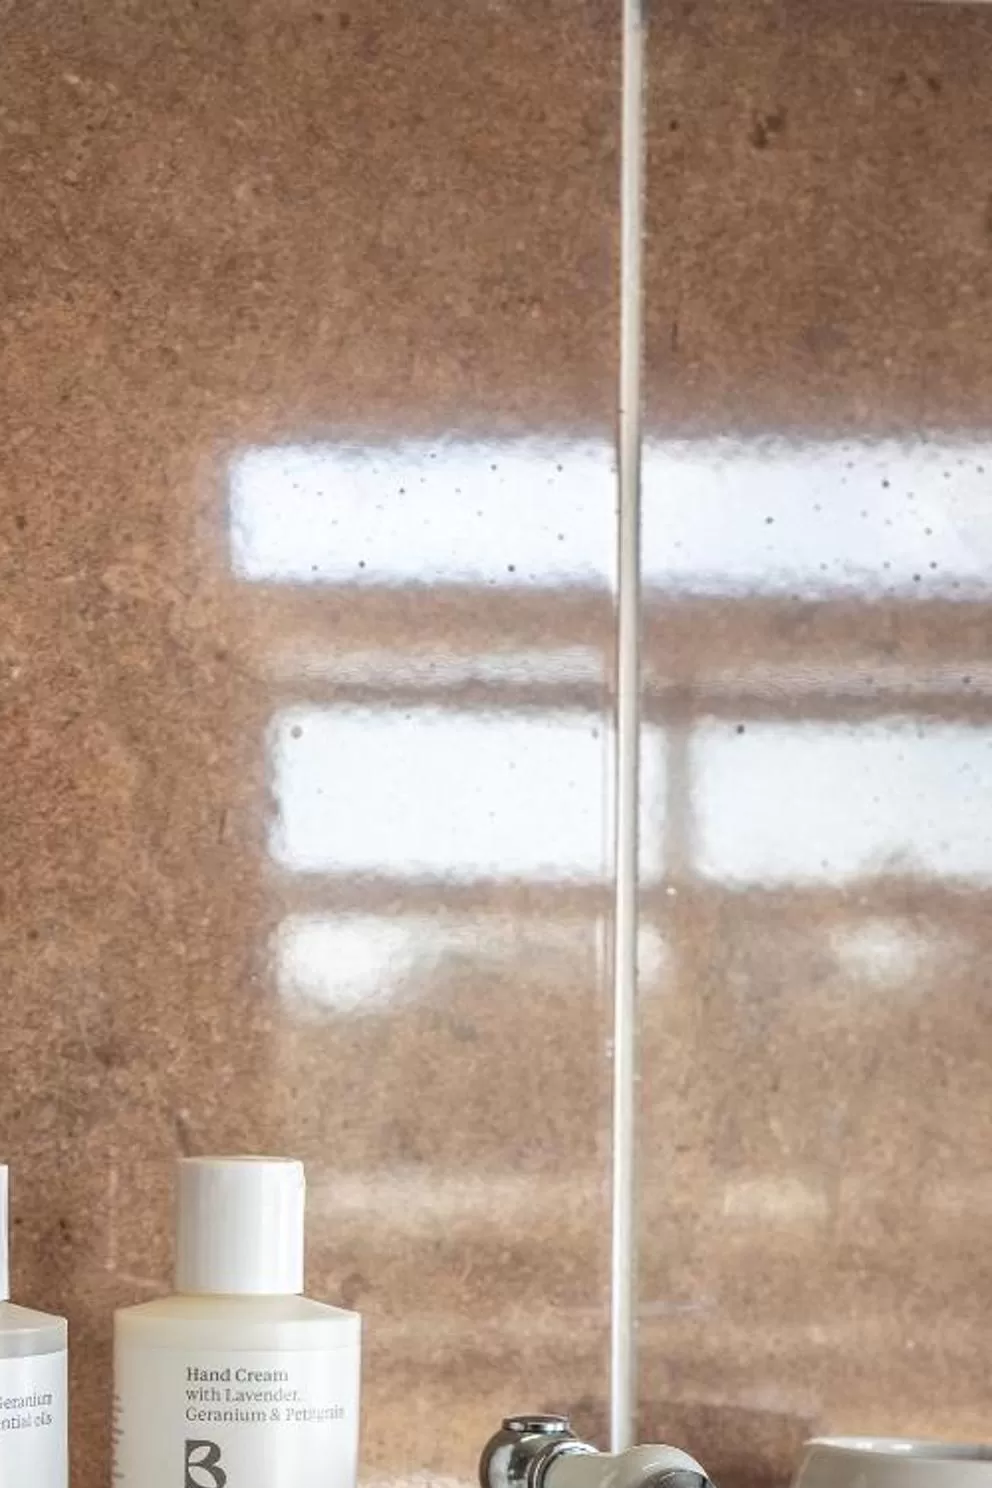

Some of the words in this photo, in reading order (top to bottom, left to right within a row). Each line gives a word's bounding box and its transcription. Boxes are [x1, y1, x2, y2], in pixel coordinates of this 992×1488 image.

[184, 1367, 231, 1383] Hand
[235, 1367, 289, 1383] Cream
[185, 1387, 221, 1402] with
[185, 1406, 268, 1423] Geranium
[269, 1407, 281, 1422] &
